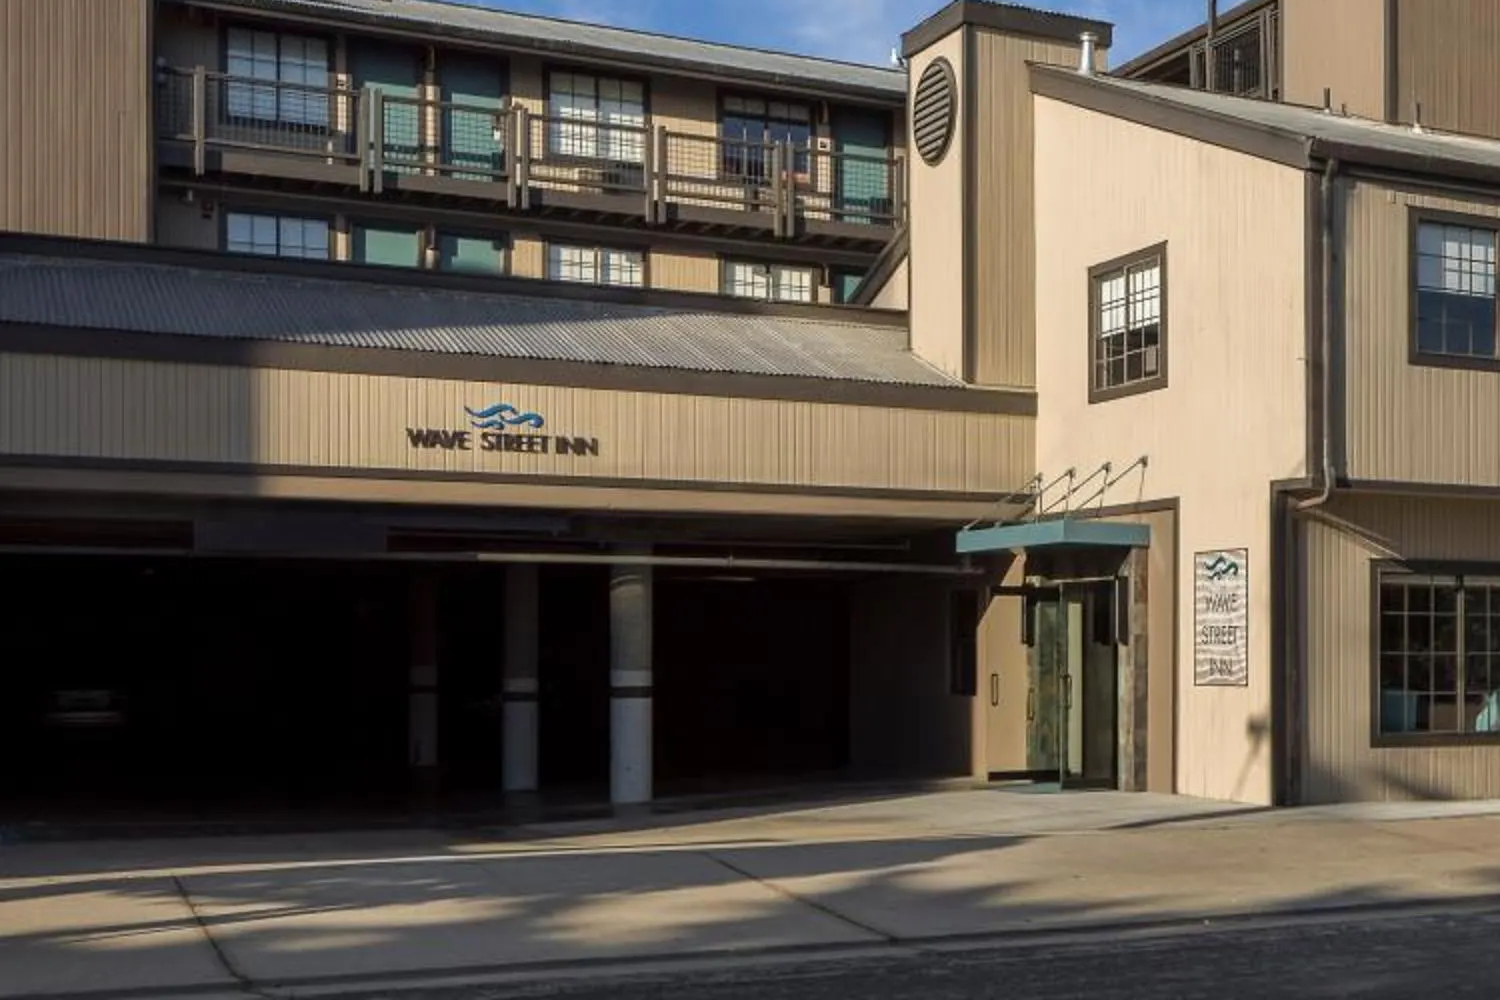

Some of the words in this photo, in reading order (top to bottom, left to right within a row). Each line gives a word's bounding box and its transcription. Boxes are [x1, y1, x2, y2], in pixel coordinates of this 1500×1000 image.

[406, 427, 473, 450] WAVE
[480, 431, 549, 454] STREET
[555, 435, 599, 457] INN
[1205, 593, 1237, 612] WAVE
[1201, 625, 1239, 644] STREET
[1209, 658, 1233, 676] INN
